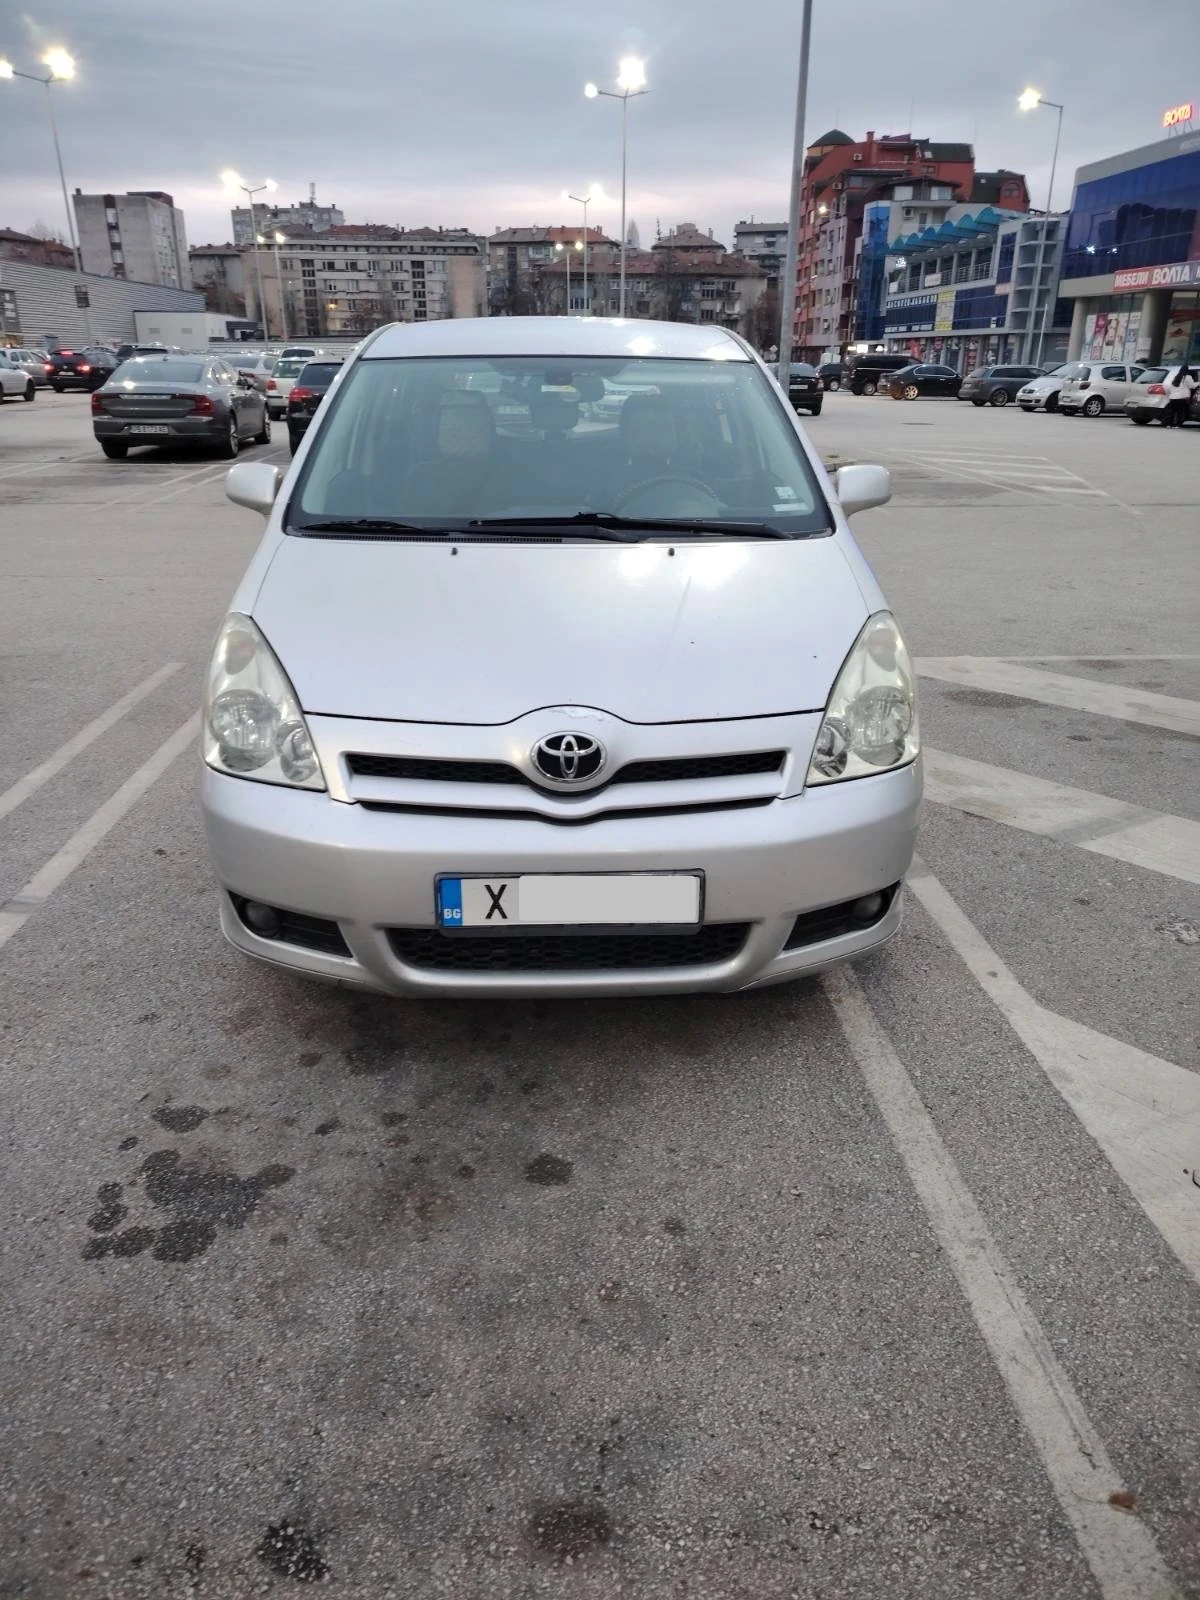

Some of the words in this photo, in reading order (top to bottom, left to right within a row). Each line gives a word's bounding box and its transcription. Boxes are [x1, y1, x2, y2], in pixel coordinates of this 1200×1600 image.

[1163, 103, 1191, 128] ВОЛТА
[1114, 271, 1149, 288] МЕБЕЛИ
[1151, 265, 1190, 285] ВОЛТА
[443, 908, 461, 919] BG
[484, 884, 508, 919] X
